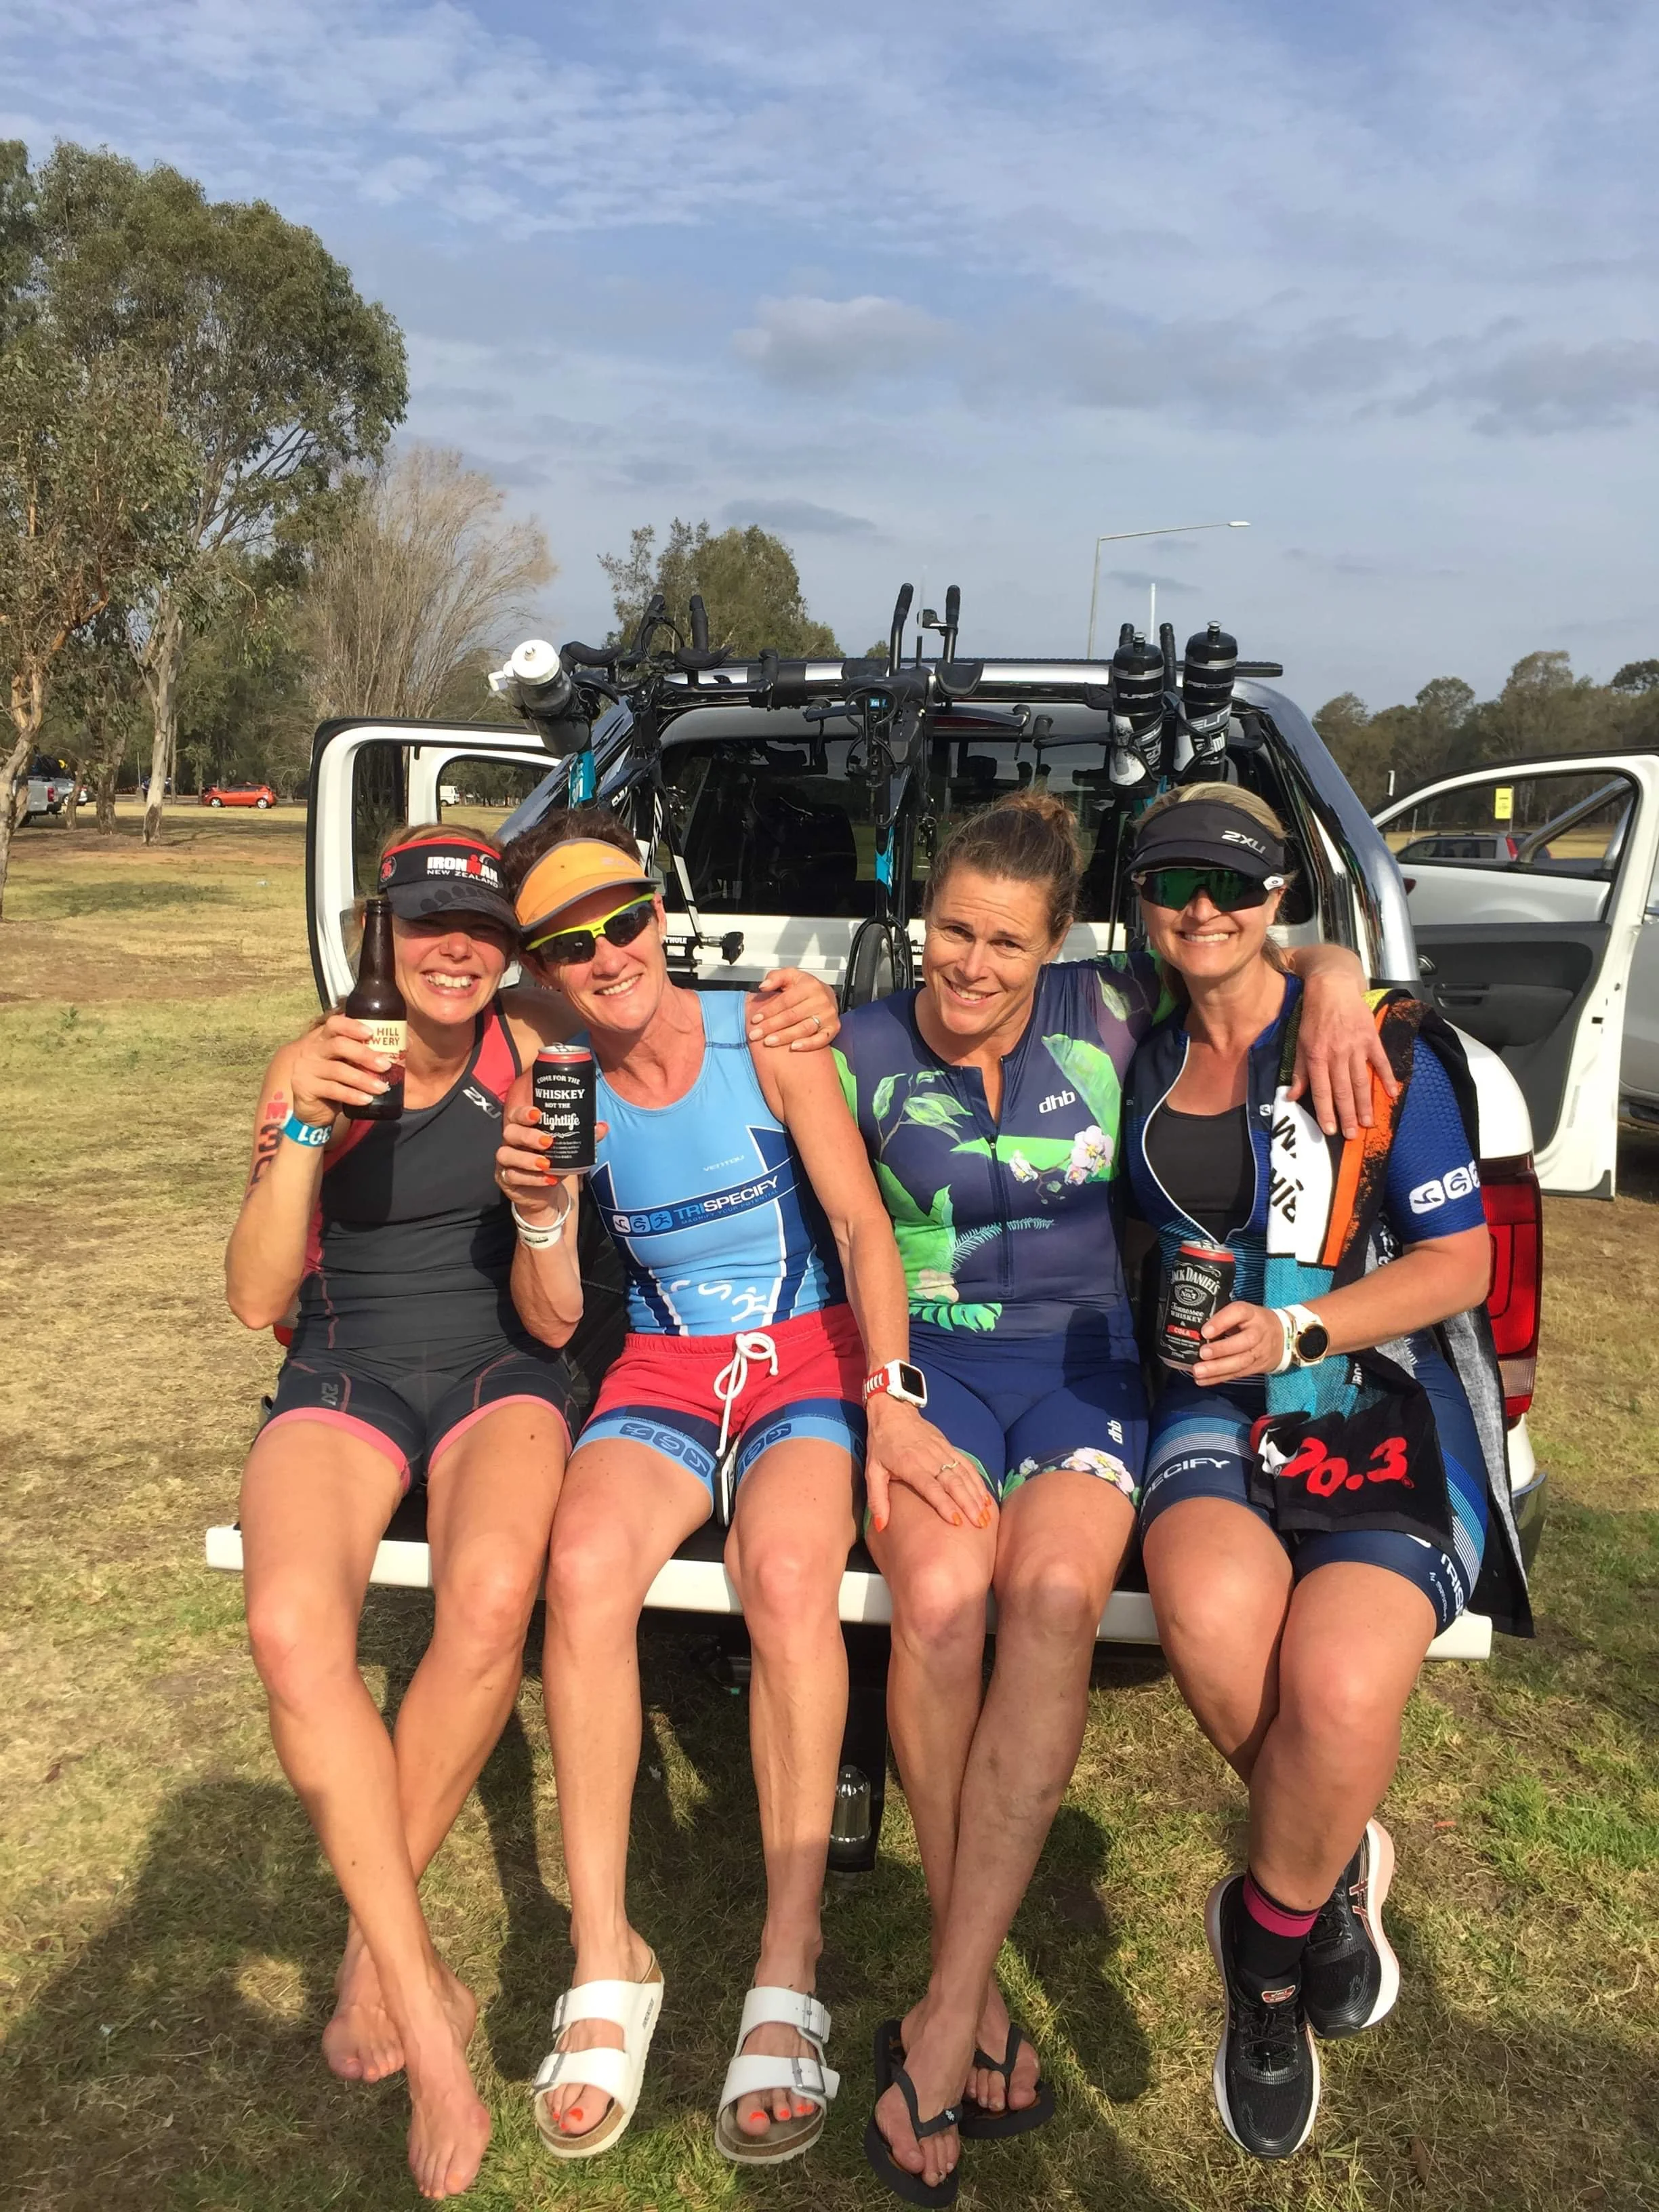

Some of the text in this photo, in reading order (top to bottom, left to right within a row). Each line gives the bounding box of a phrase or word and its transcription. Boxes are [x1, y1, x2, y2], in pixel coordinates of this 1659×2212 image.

[1221, 830, 1266, 854] 2XU
[427, 854, 498, 882] IRONMAN
[455, 870, 499, 888] ZEALAND
[377, 1027, 398, 1036] HILL
[537, 1076, 552, 1084] COME
[567, 1076, 581, 1085] THE
[462, 1086, 502, 1118] 2XU
[535, 1088, 586, 1099] WHISKEY
[1039, 1090, 1076, 1113] dhb
[539, 1112, 581, 1130] Nightlife
[674, 1175, 778, 1220] TRISPECIFY
[681, 1189, 779, 1225] MAGNIFY YOUR POTENTIAL
[1171, 1302, 1204, 1317] Tennessee
[1171, 1311, 1202, 1323] WHISKEY
[1174, 1327, 1191, 1336] COLA
[1107, 1420, 1124, 1446] dhb
